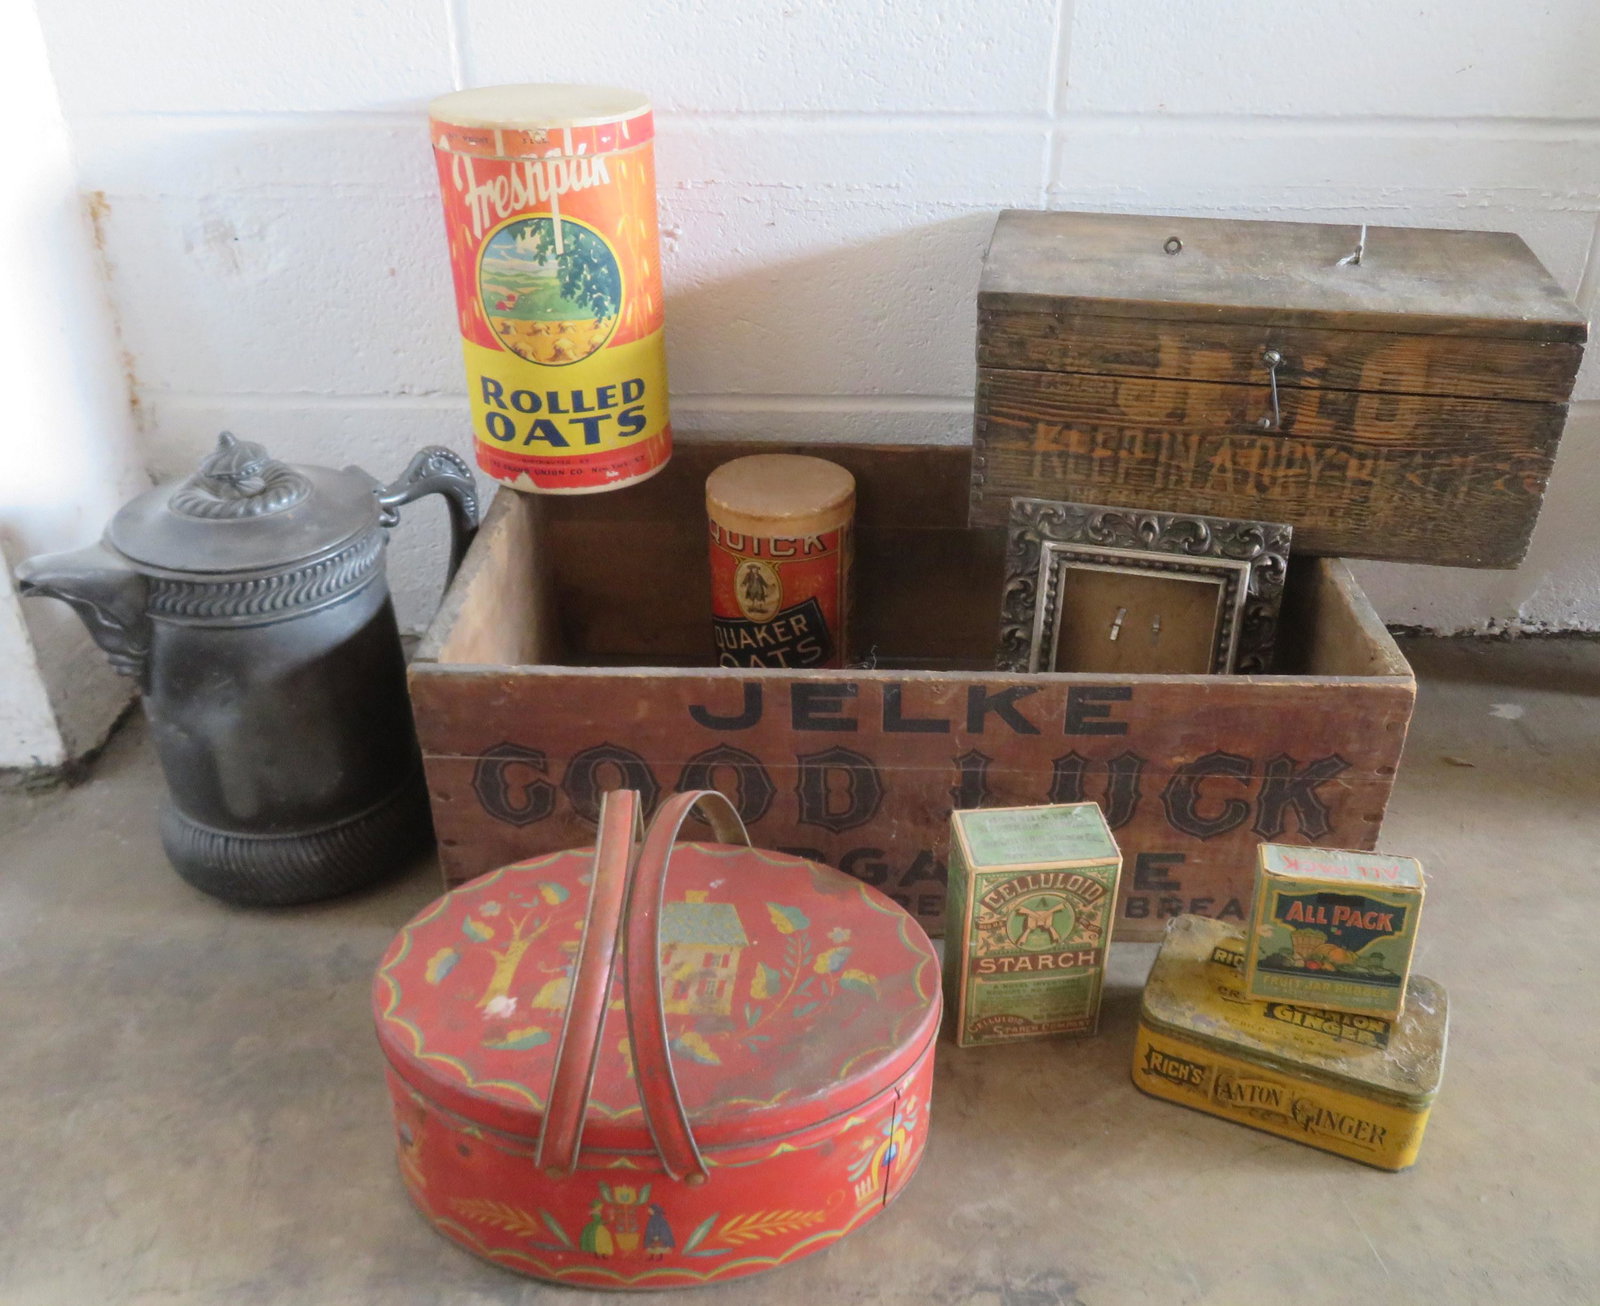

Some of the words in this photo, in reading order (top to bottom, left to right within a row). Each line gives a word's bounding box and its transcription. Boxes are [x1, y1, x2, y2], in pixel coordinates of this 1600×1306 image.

[453, 143, 611, 255] Freshpak
[480, 375, 646, 414] ROLLED
[485, 404, 647, 448] OATS
[534, 468, 565, 476] UNION
[715, 613, 809, 650] QUAKER
[719, 636, 822, 668] OATS
[688, 682, 1133, 736] JELKE
[471, 741, 886, 834] GOOD
[985, 872, 1104, 909] CELLULOID
[1125, 896, 1246, 921] BREA
[1285, 900, 1328, 926] ALL
[1331, 904, 1395, 933] PACK
[976, 951, 1096, 974] STARCH
[1214, 949, 1246, 967] RIC
[1262, 973, 1301, 989] FRUIT
[1304, 980, 1331, 992] JAR
[1149, 1050, 1203, 1084] RICH'S
[1212, 1072, 1282, 1107] CANTON
[1290, 1098, 1388, 1146] GINGER
